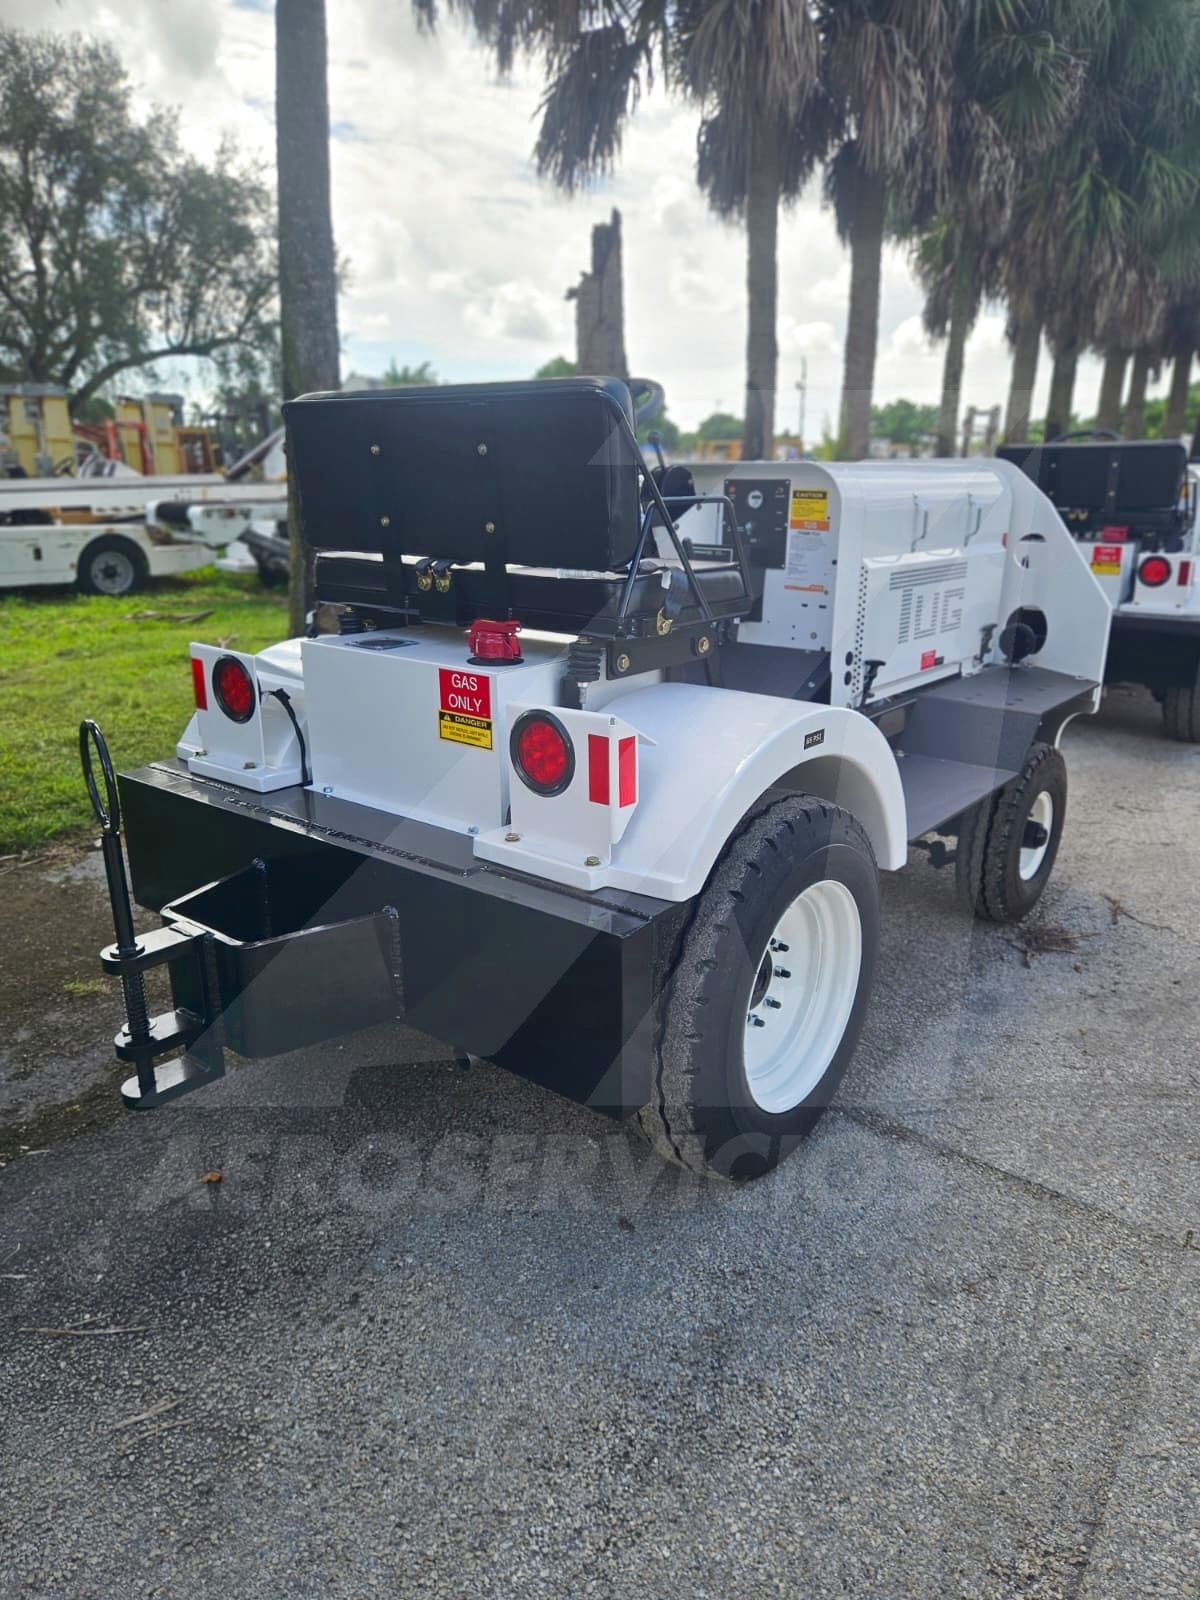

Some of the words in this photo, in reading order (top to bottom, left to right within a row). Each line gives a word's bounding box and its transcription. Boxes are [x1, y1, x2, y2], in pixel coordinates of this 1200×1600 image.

[889, 562, 968, 644] TUG
[451, 673, 478, 692] GAS
[448, 693, 482, 713] ONLY
[454, 716, 487, 729] DANGER
